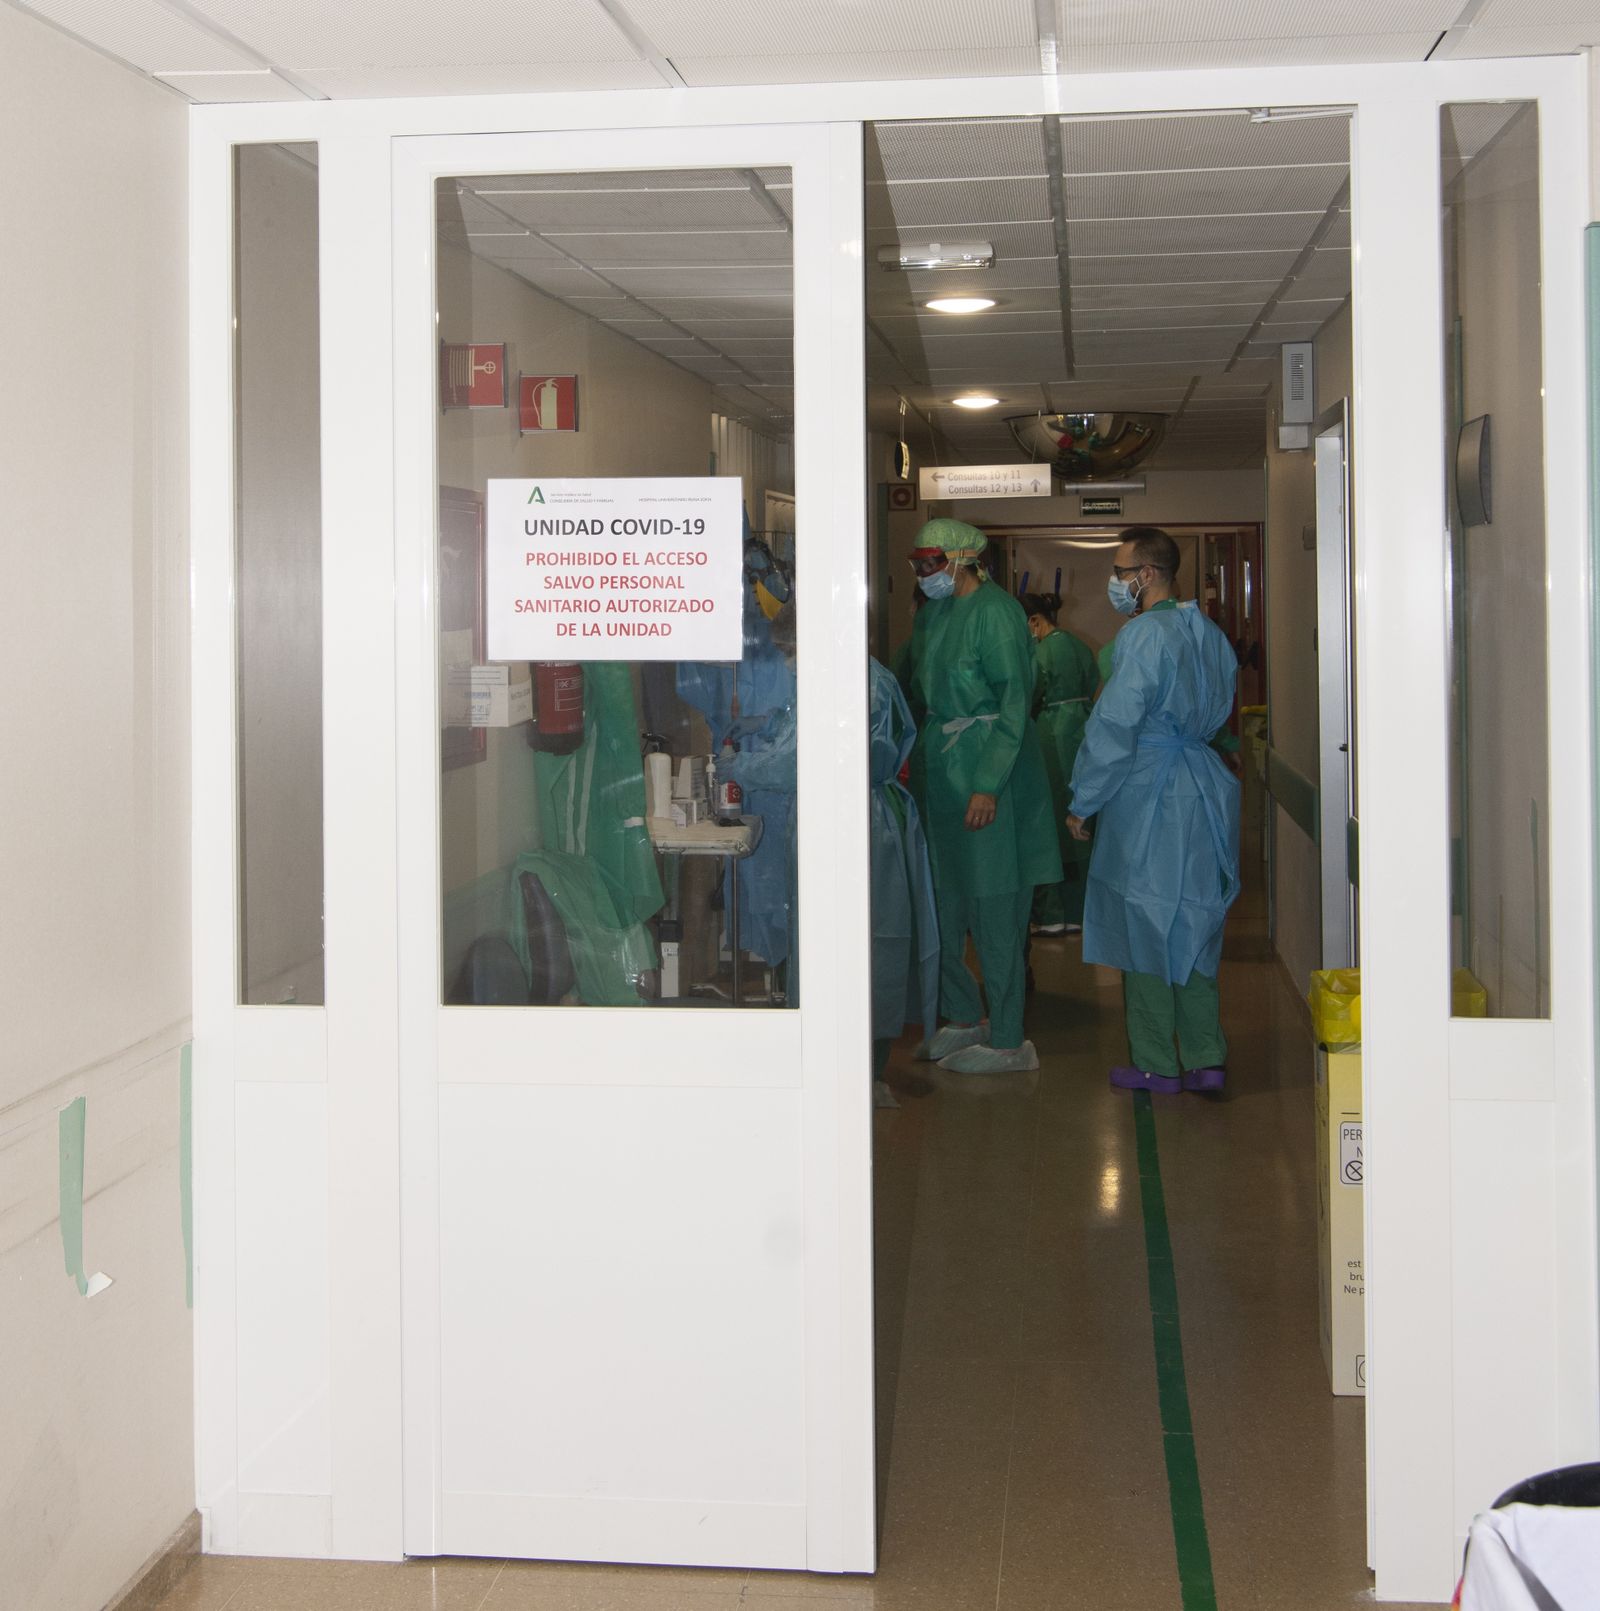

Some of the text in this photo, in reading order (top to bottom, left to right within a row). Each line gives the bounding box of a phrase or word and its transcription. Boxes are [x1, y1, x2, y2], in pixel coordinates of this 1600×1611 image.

[947, 470, 1021, 481] Consultas 10 y 11
[948, 483, 1023, 494] Consultas 12 y 13
[524, 518, 706, 536] UNIDAD COVID-19
[525, 552, 708, 566] PROHIBIDO EL ACCESO
[543, 575, 685, 590] SALVO PERSONAL
[514, 599, 715, 613] SANITARIO AUTORIZADO
[556, 623, 673, 637] DE LA UNIDAD
[1347, 1260, 1362, 1268] est
[1343, 1285, 1357, 1294] Ne
